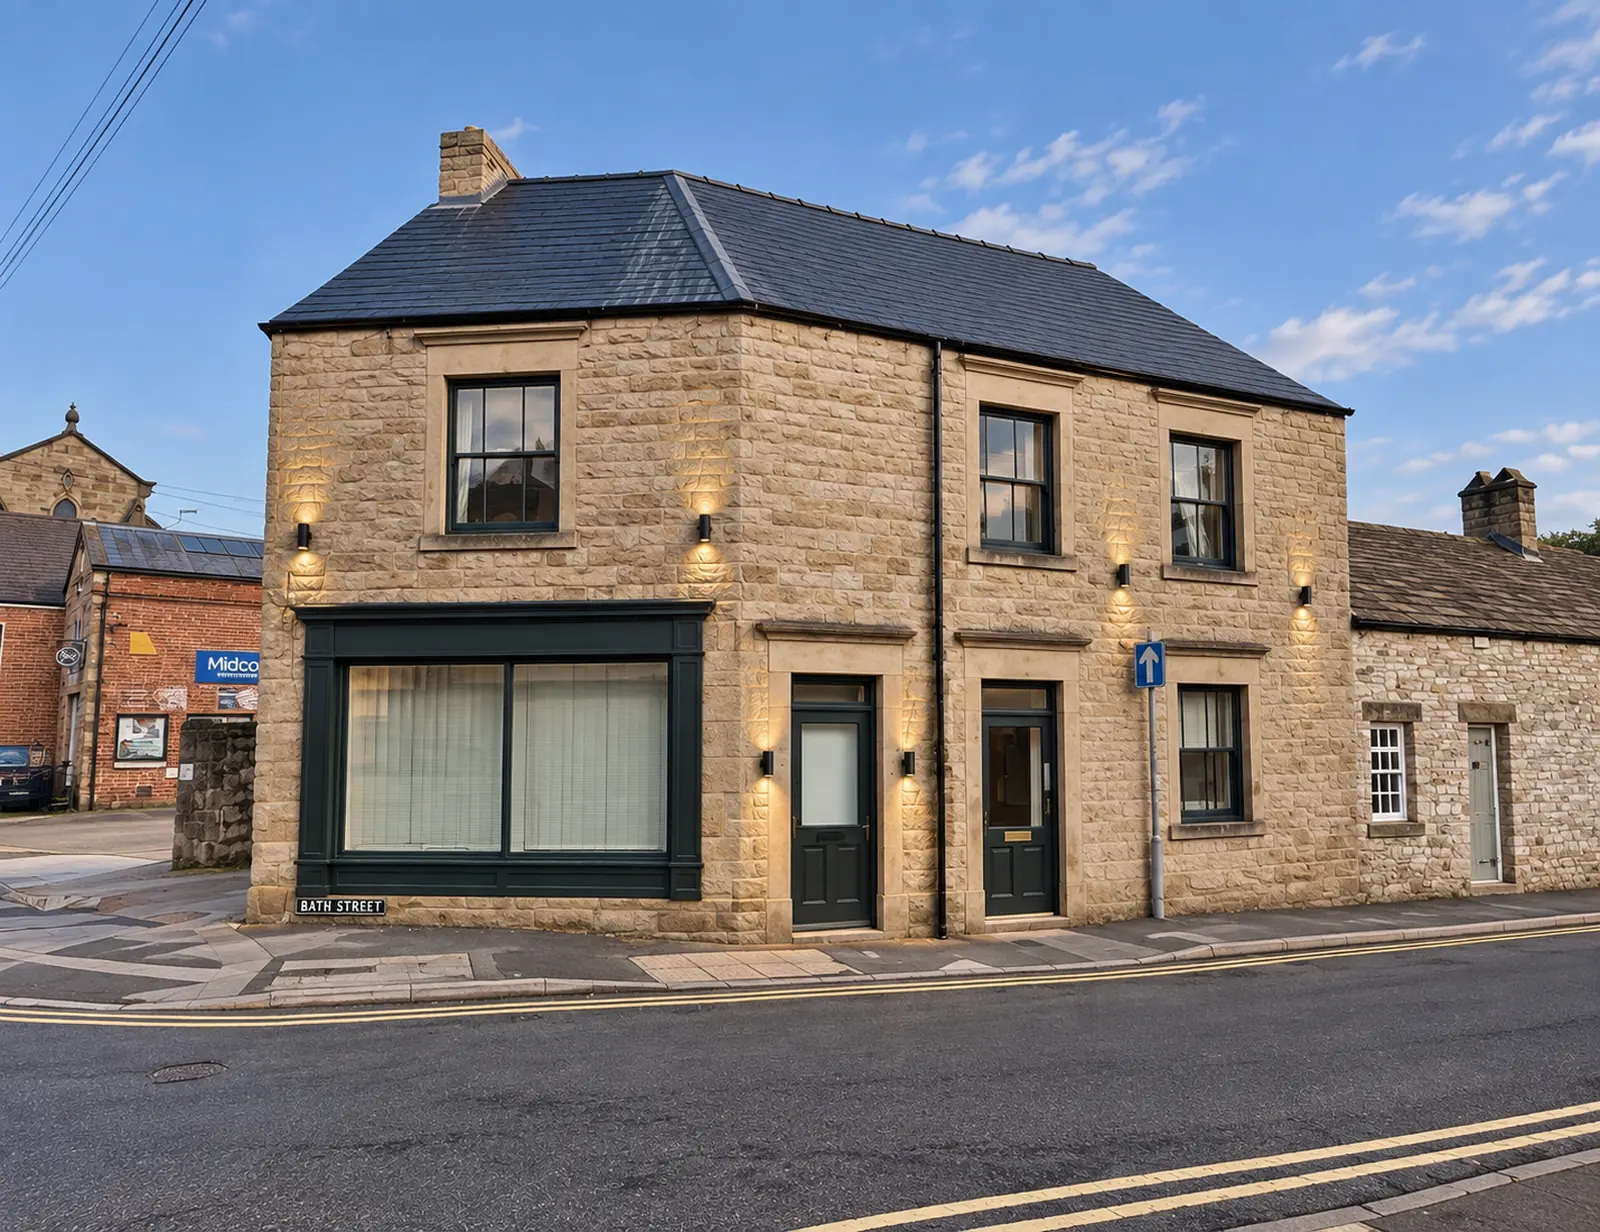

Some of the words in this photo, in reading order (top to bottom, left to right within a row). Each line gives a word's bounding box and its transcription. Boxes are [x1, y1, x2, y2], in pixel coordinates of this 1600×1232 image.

[208, 656, 259, 672] Midco
[300, 900, 332, 912] BATH
[336, 900, 382, 912] STREET
